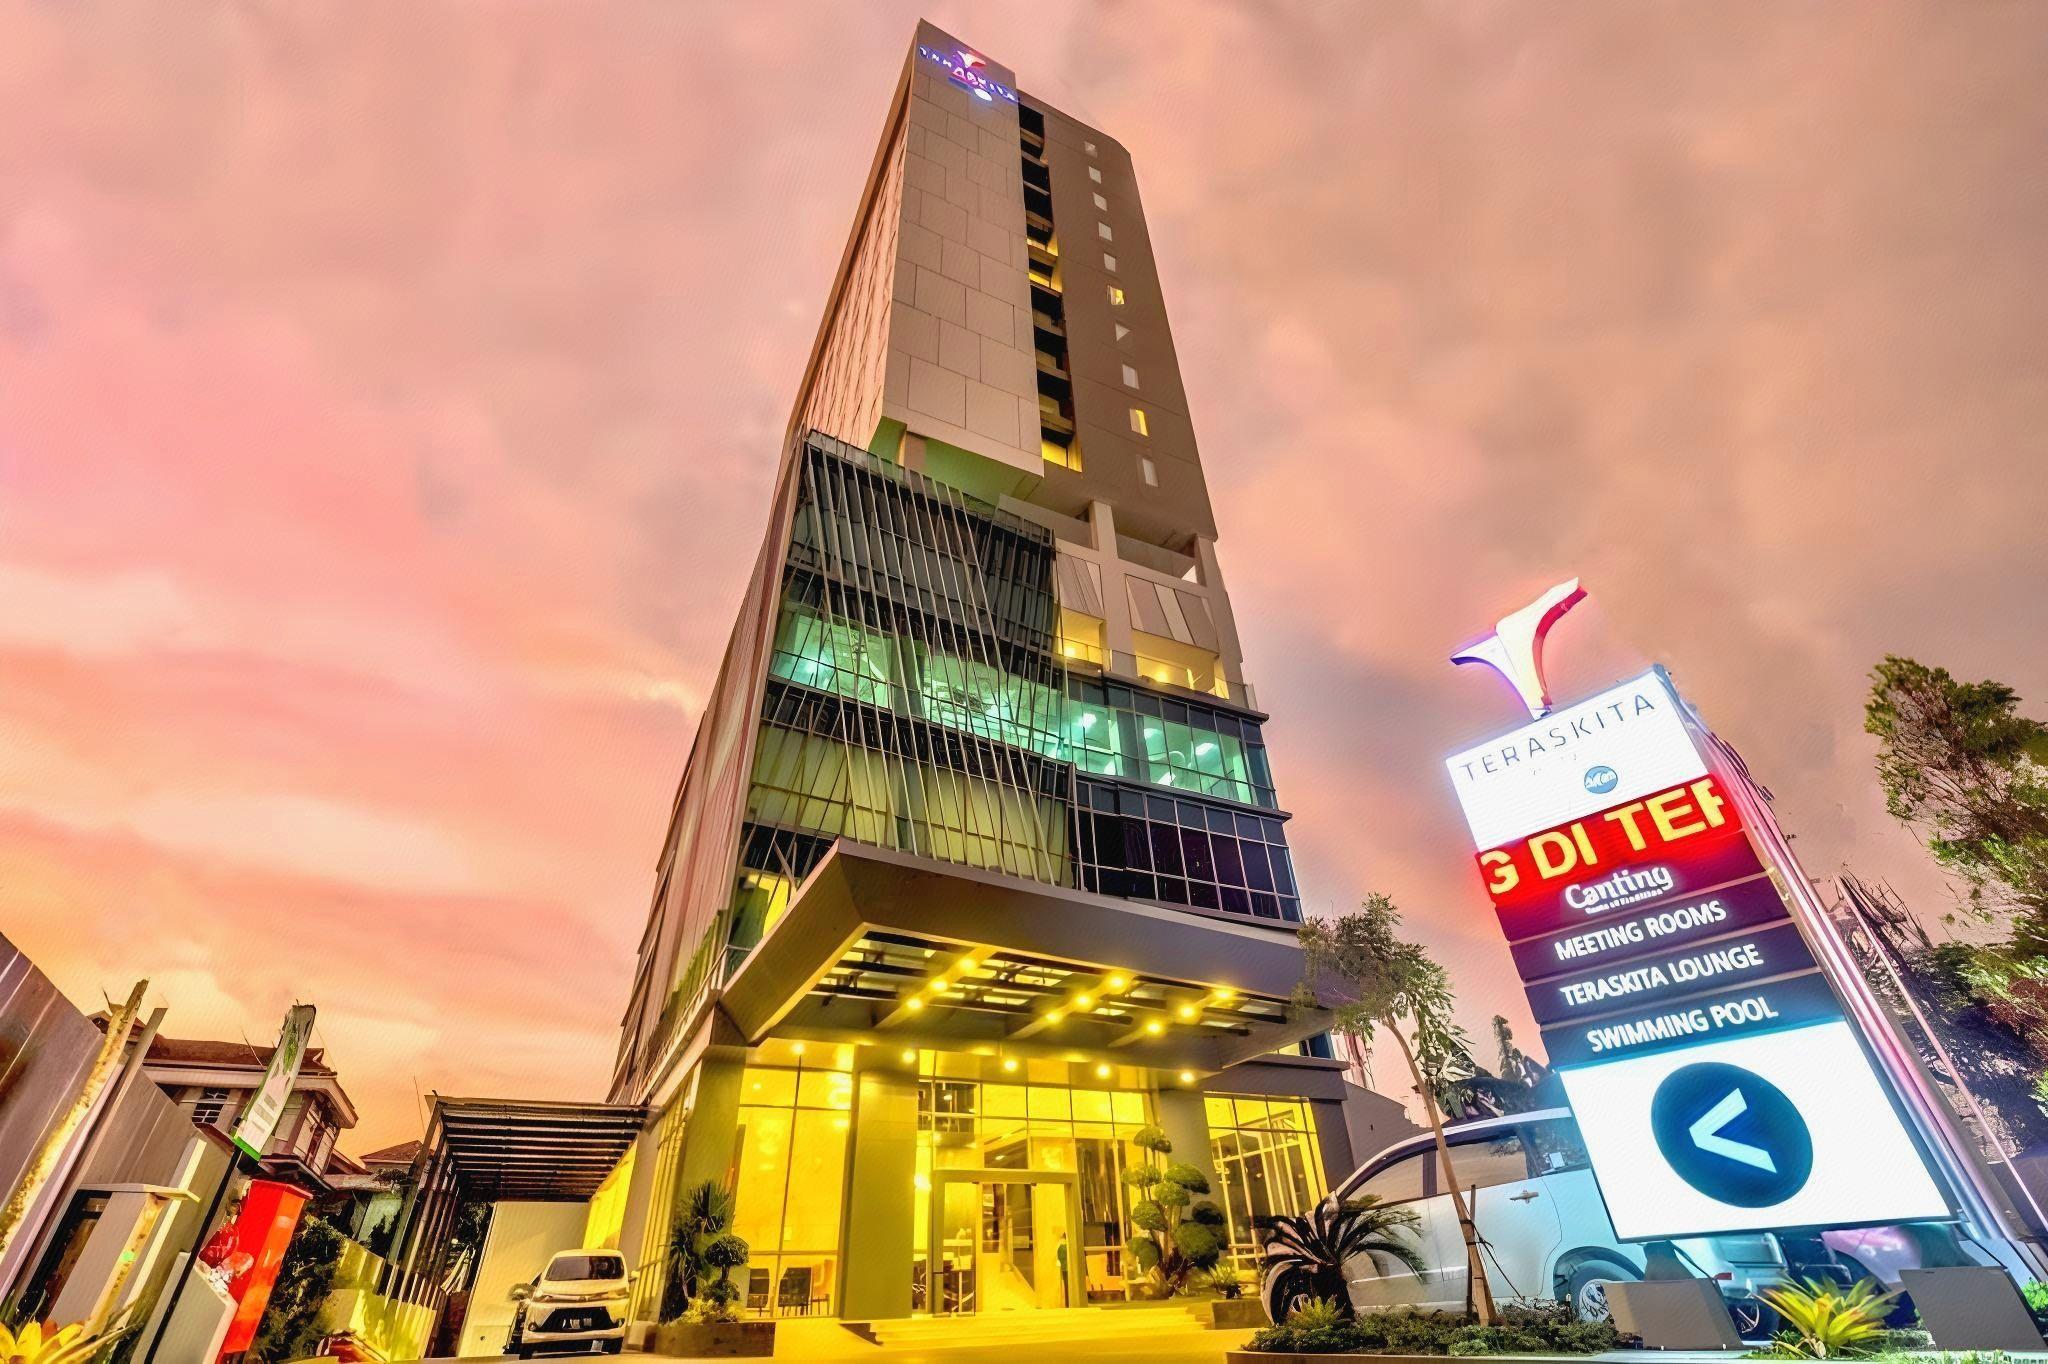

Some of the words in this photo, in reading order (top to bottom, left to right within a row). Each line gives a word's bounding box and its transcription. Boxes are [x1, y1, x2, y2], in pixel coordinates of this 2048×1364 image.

[1460, 694, 1655, 781] TERASKITA
[1528, 822, 1598, 880] DI
[1565, 867, 1673, 908] Canting
[1554, 922, 1644, 960] MEETING
[1644, 900, 1727, 937] ROOMS
[1559, 966, 1669, 1006] TERASKITA
[1668, 943, 1764, 982] LOUNGE
[1586, 1009, 1709, 1052] SWIMMING
[1709, 997, 1778, 1028] POOL
